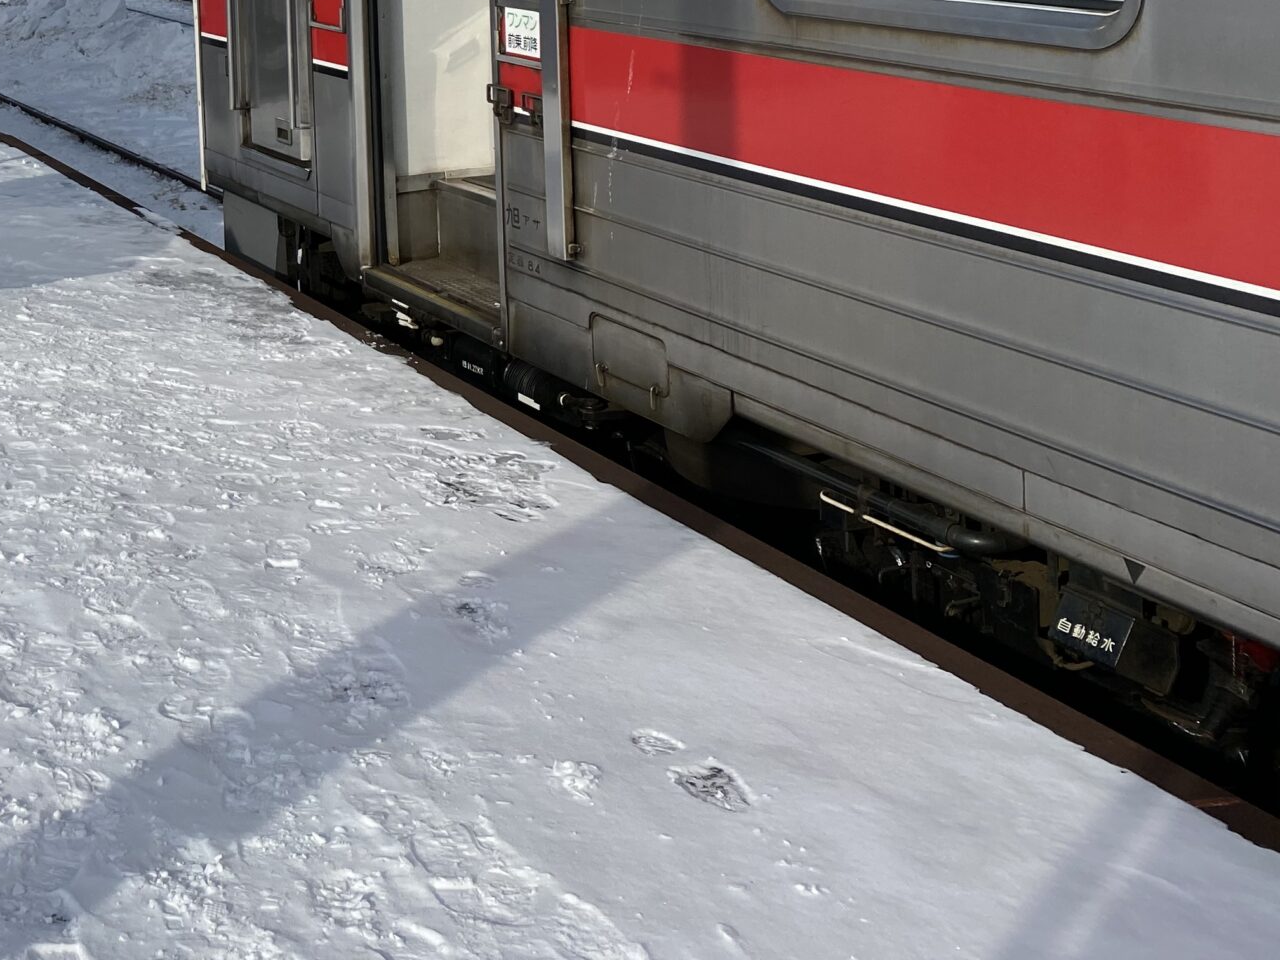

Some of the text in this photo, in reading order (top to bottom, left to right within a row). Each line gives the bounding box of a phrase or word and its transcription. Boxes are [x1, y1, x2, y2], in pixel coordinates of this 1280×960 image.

[507, 12, 538, 31] ワンマン
[507, 33, 538, 52] 前乗前降
[527, 260, 541, 275] 84
[1057, 617, 1116, 653] 自動給水
